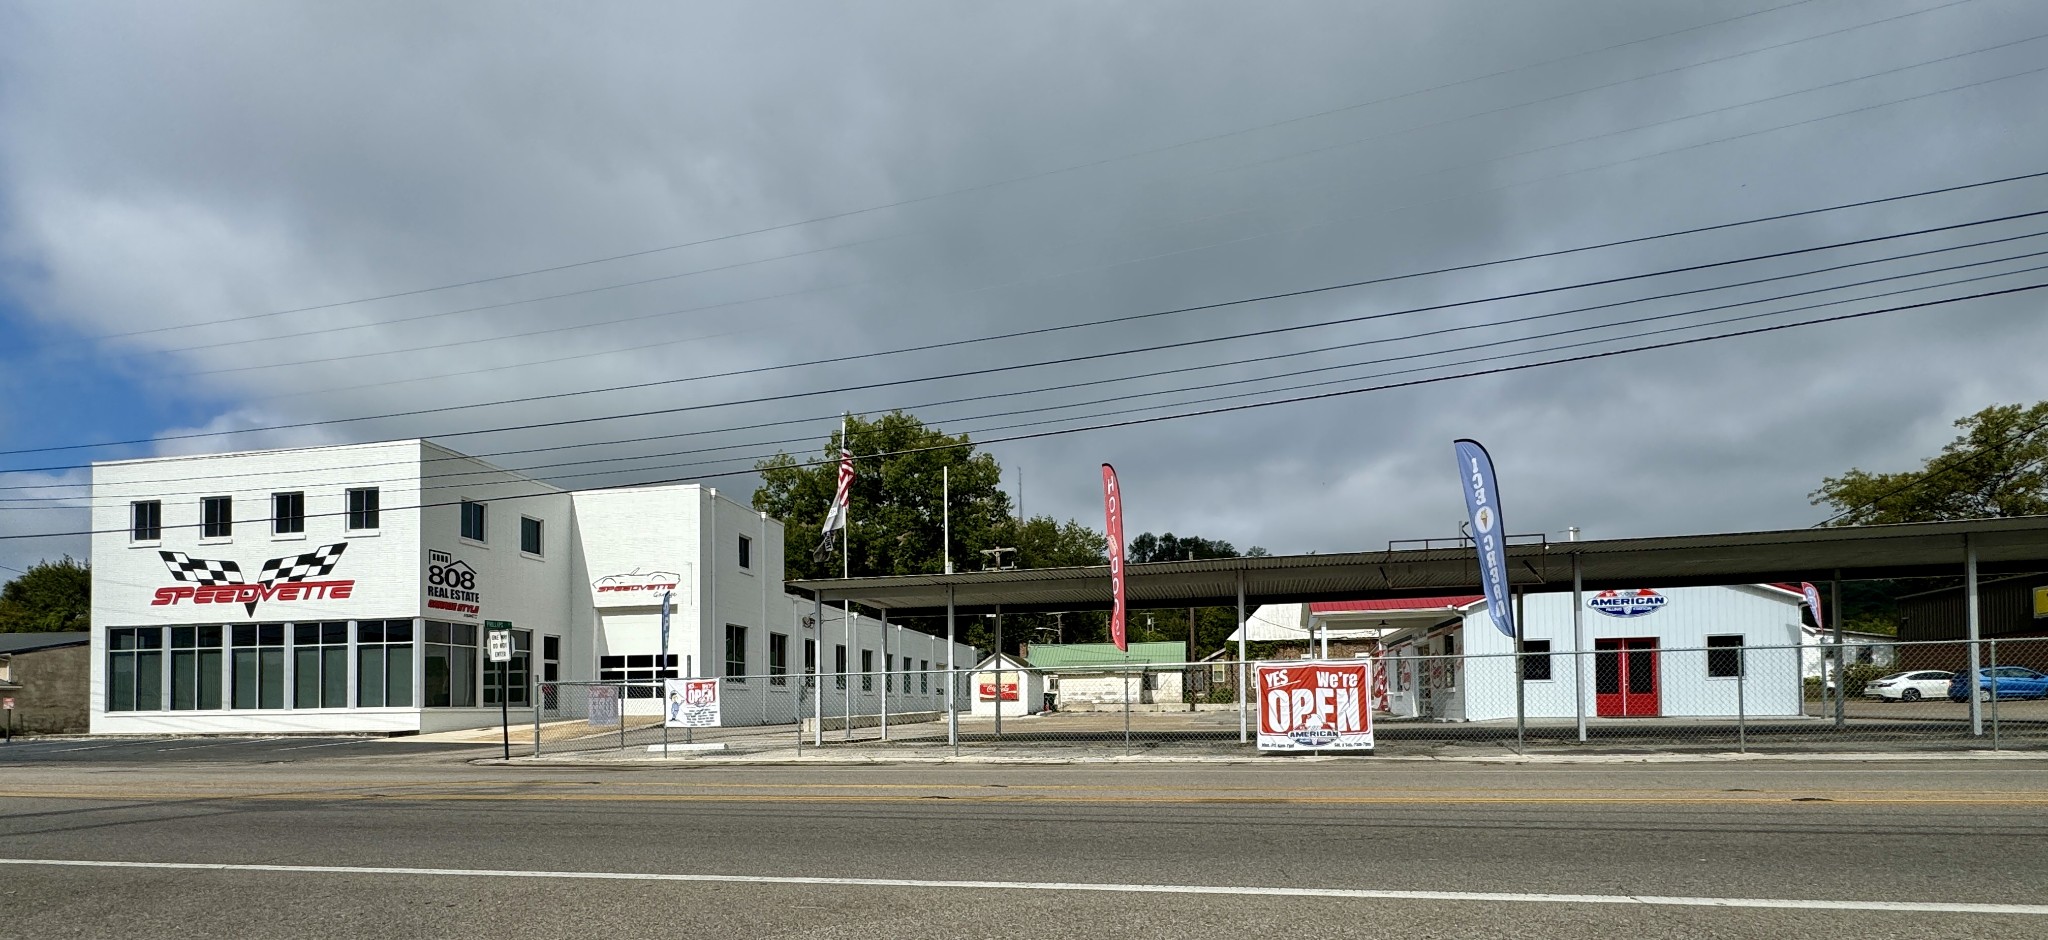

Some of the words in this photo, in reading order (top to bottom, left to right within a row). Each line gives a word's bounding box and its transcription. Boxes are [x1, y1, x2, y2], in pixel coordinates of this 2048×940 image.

[429, 565, 475, 590] 808
[150, 579, 356, 607] SPEEDVETTE
[428, 586, 449, 599] REAL
[450, 589, 479, 603] ESTATE
[597, 583, 677, 593] SPEEDVETTE
[1590, 597, 1665, 606] AMERICAN
[1265, 669, 1289, 688] YES
[1316, 671, 1359, 688] We're
[688, 689, 713, 703] OPEN
[1268, 688, 1361, 732] OPEN
[1289, 730, 1339, 738] AMERICAN
